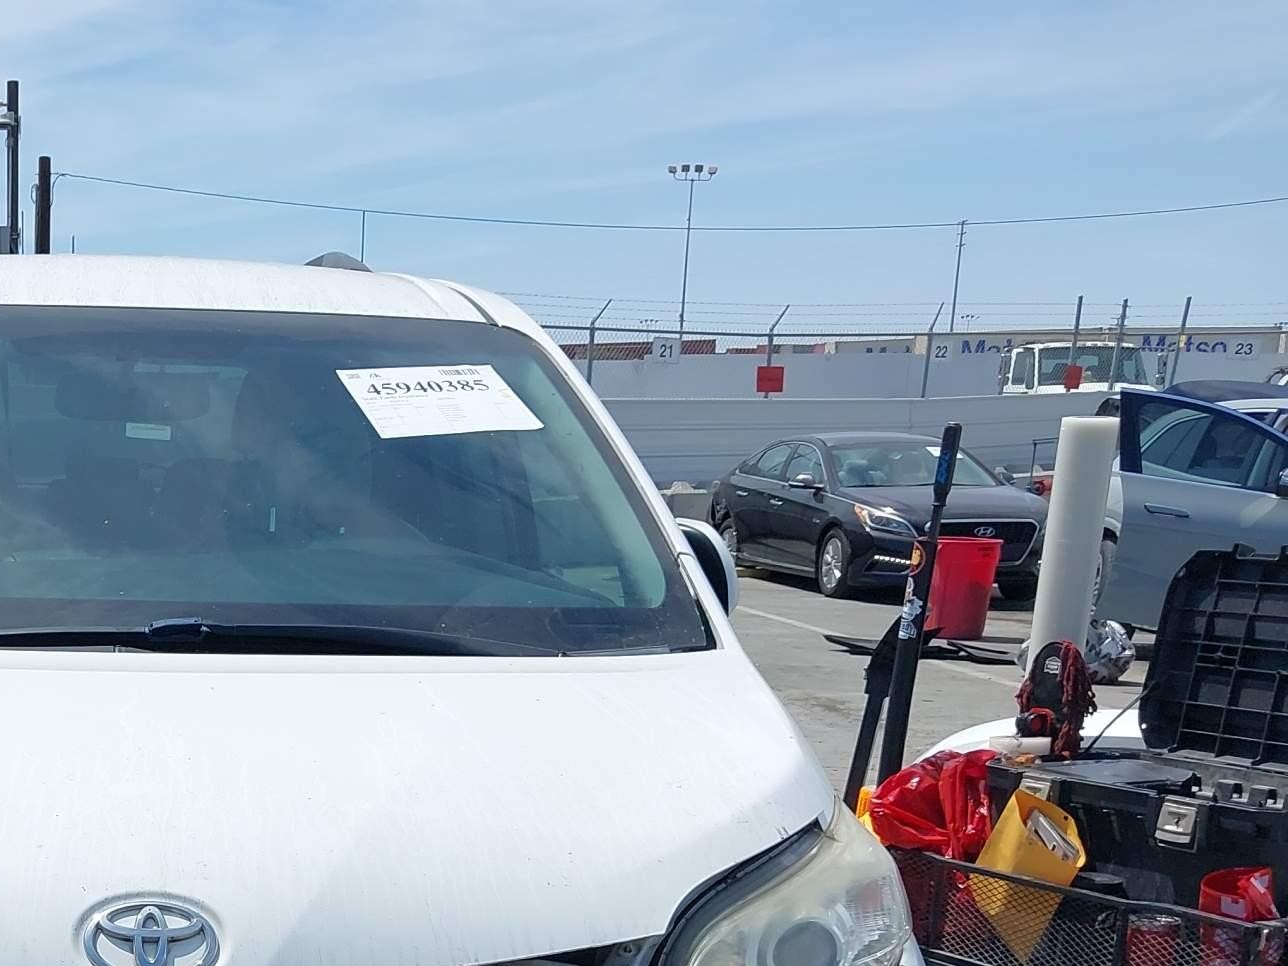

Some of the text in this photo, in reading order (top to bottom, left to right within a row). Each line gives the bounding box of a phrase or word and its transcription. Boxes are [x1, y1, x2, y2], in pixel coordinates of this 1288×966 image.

[659, 343, 673, 359] 21
[935, 345, 948, 359] 22
[1234, 342, 1254, 356] 23
[367, 379, 490, 396] 45940385
